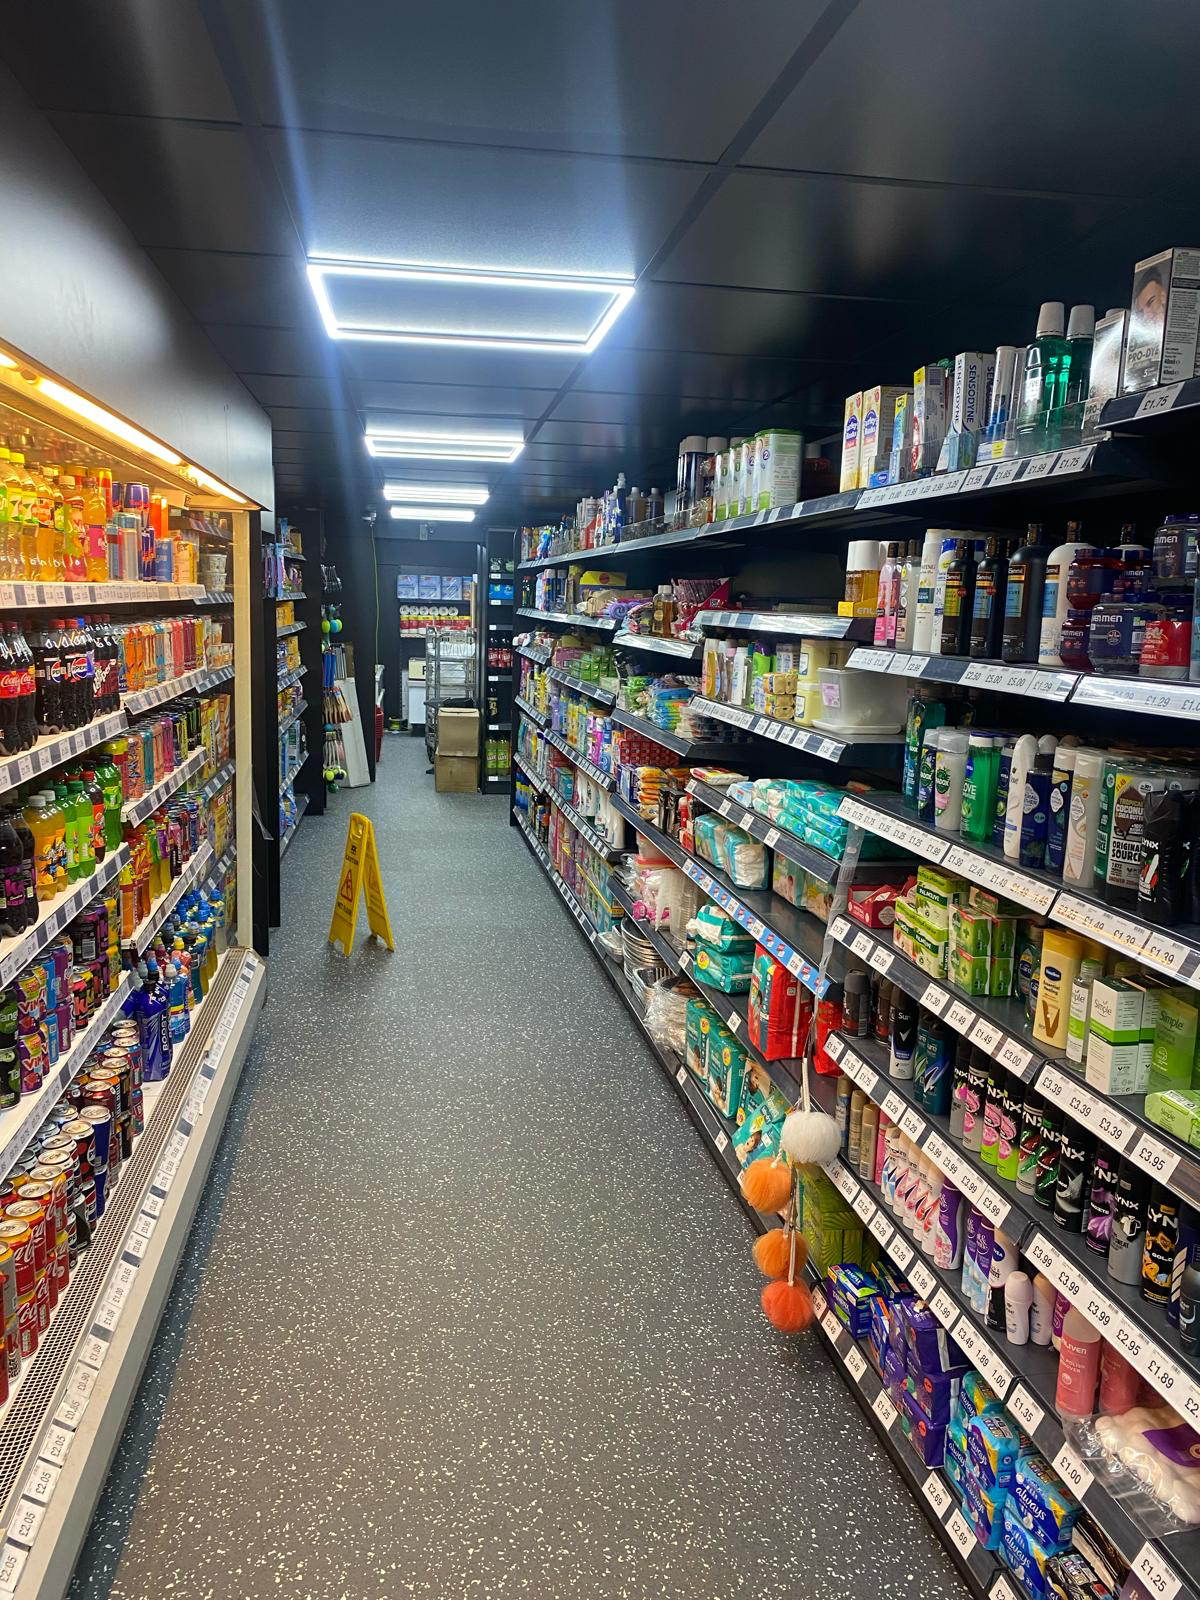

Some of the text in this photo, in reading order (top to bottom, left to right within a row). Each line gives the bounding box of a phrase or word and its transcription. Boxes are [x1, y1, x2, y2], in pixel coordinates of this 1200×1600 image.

[965, 364, 975, 423] SENSODYNE
[1142, 396, 1168, 411] £1.75
[1058, 457, 1080, 469] £1.75
[1144, 695, 1171, 709] £1.29
[967, 864, 985, 878] £2.49
[950, 1010, 967, 1025] £1.49
[1160, 1009, 1184, 1030] Simple
[161, 1013, 169, 1052] BOOST
[974, 1028, 993, 1046] £1.49
[1002, 1048, 1023, 1068] £3.00
[1041, 1076, 1063, 1097] £3.39
[1068, 1096, 1092, 1118] £3.39
[903, 1117, 918, 1134] £3.29
[1098, 1116, 1123, 1141] £3.39
[927, 1141, 942, 1158] £3.99
[1137, 1147, 1166, 1171] £3.95
[942, 1157, 958, 1175] £3.99
[960, 1175, 978, 1194] £3.99
[982, 1196, 1001, 1217] £3.99
[1147, 1206, 1179, 1228] LYN
[892, 1244, 907, 1262] £3.29
[1032, 1245, 1053, 1268] £3.99
[913, 1270, 928, 1290] £1.99
[1058, 1271, 1080, 1296] £3.99
[935, 1299, 951, 1320] £1.99
[1086, 1300, 1111, 1327] £3.99
[957, 1327, 975, 1350] £3.49
[1115, 1328, 1142, 1357] £2.95
[89, 1343, 102, 1362] £1.09
[975, 1348, 989, 1368] 1.89
[990, 1368, 1006, 1389] 1.00
[1147, 1359, 1175, 1390] £1.89
[876, 1400, 891, 1421] £1.25
[1013, 1396, 1034, 1422] £1.35
[51, 1435, 66, 1458] £2.05
[948, 1441, 967, 1468] always
[968, 1435, 988, 1466] always
[1059, 1457, 1082, 1486] £1.00
[35, 1472, 52, 1496] £2.05
[927, 1481, 943, 1506] £2.69
[1015, 1486, 1048, 1522] always
[19, 1512, 36, 1537] £2.05
[951, 1521, 968, 1546] £2.69
[1004, 1533, 1032, 1569] always
[0, 1555, 17, 1583] £2.05
[1140, 1557, 1168, 1593] £1.25
